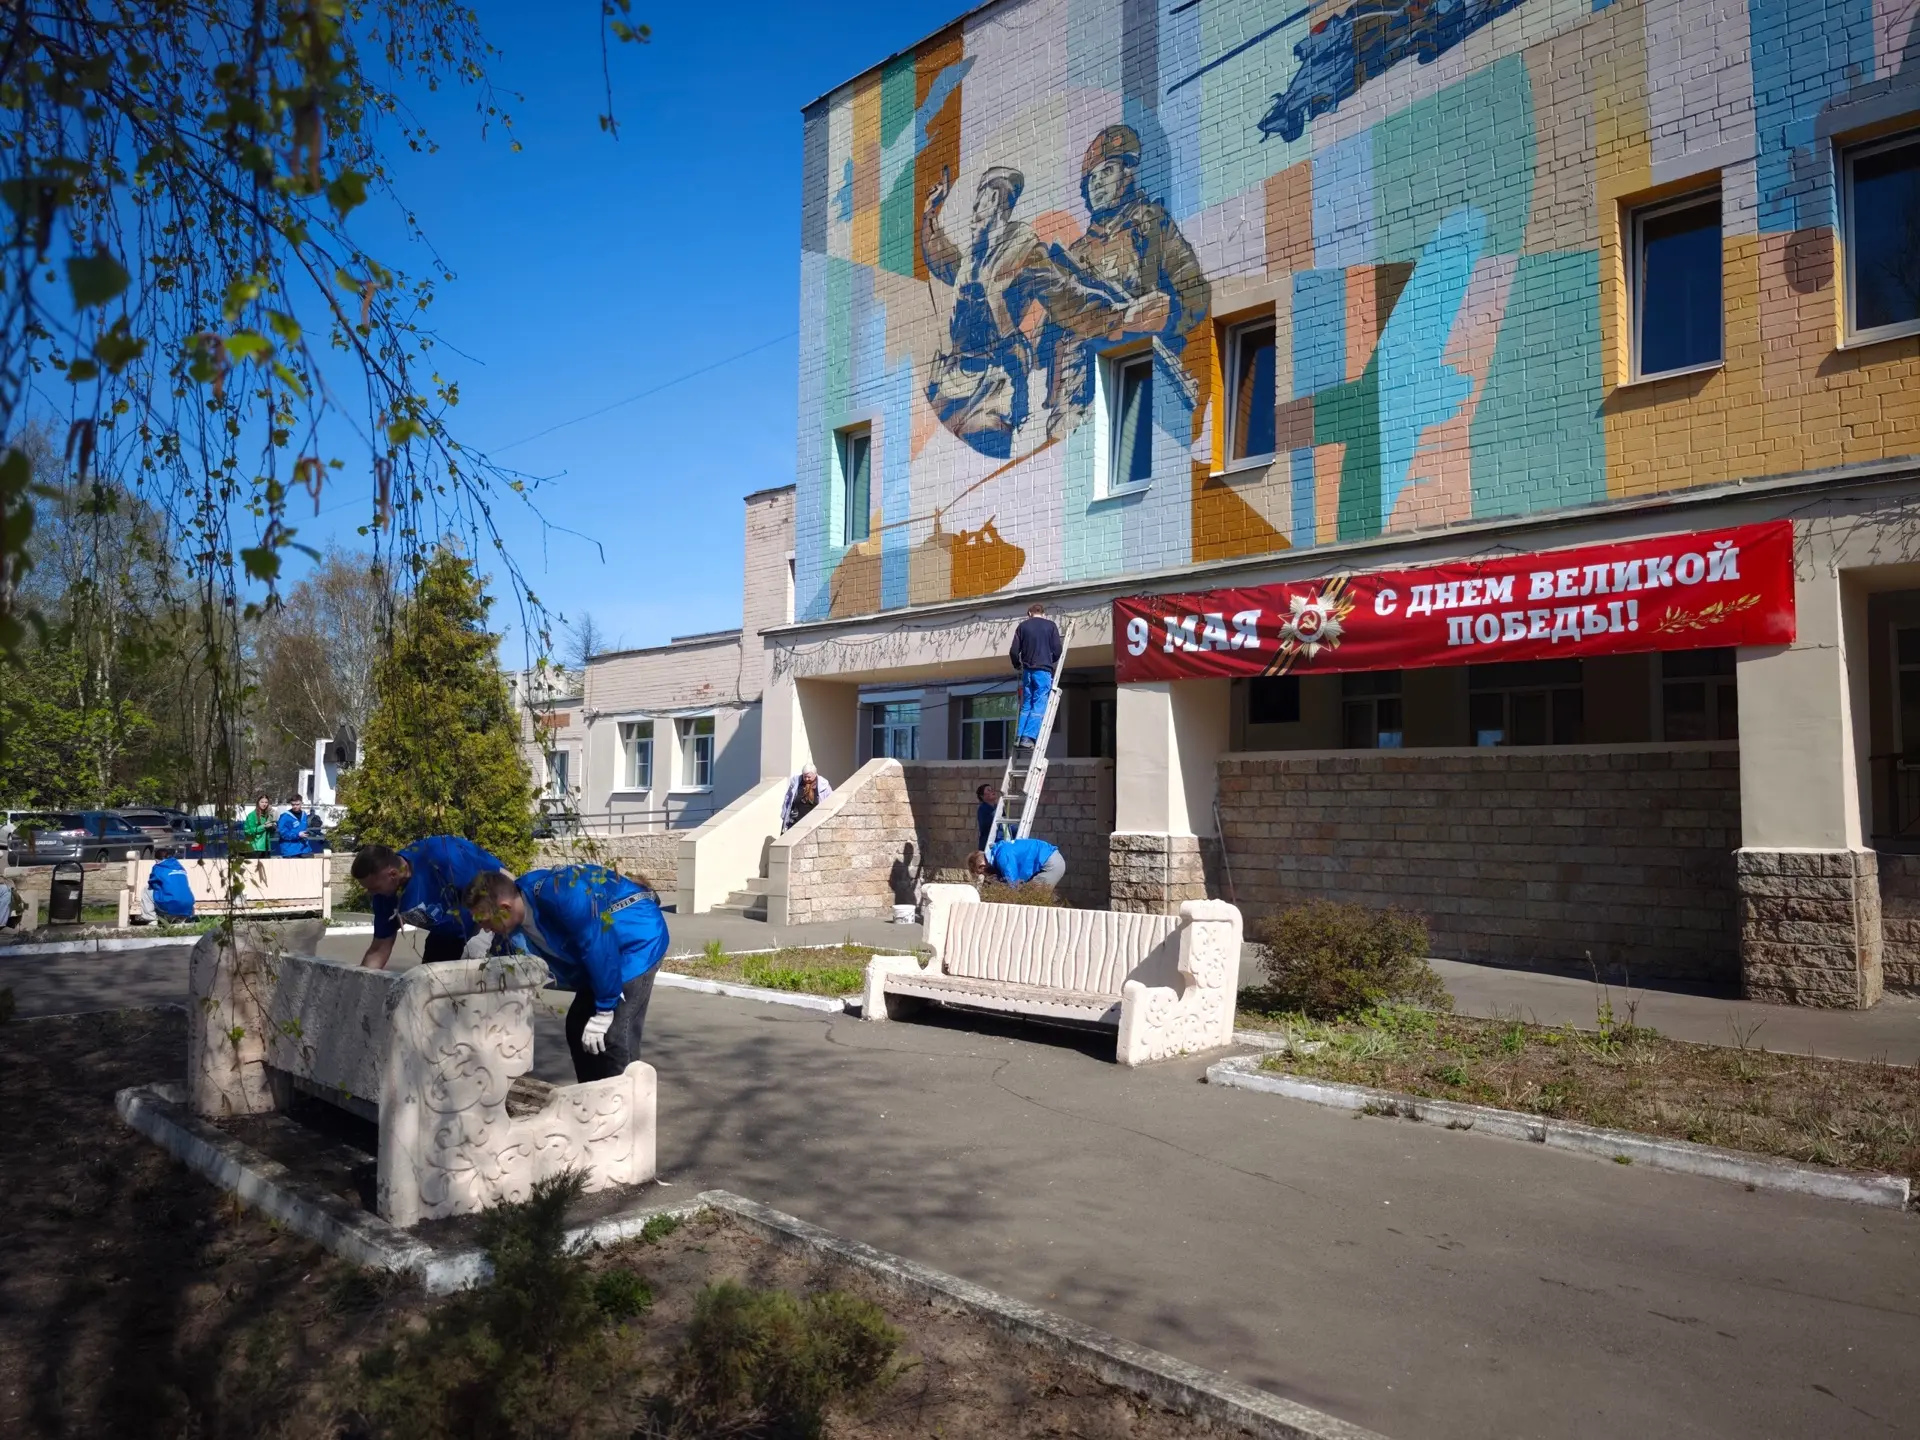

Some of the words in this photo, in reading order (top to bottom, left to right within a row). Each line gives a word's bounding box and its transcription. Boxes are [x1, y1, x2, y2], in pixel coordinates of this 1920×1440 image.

[1374, 588, 1397, 616] С
[1405, 575, 1515, 618] ДНЕМ
[1528, 540, 1740, 600] ВЕЛИКОЙ
[1127, 617, 1148, 656] 9
[1163, 609, 1262, 653] МАЯ
[1446, 599, 1639, 646] ПОБЕДЫ!
